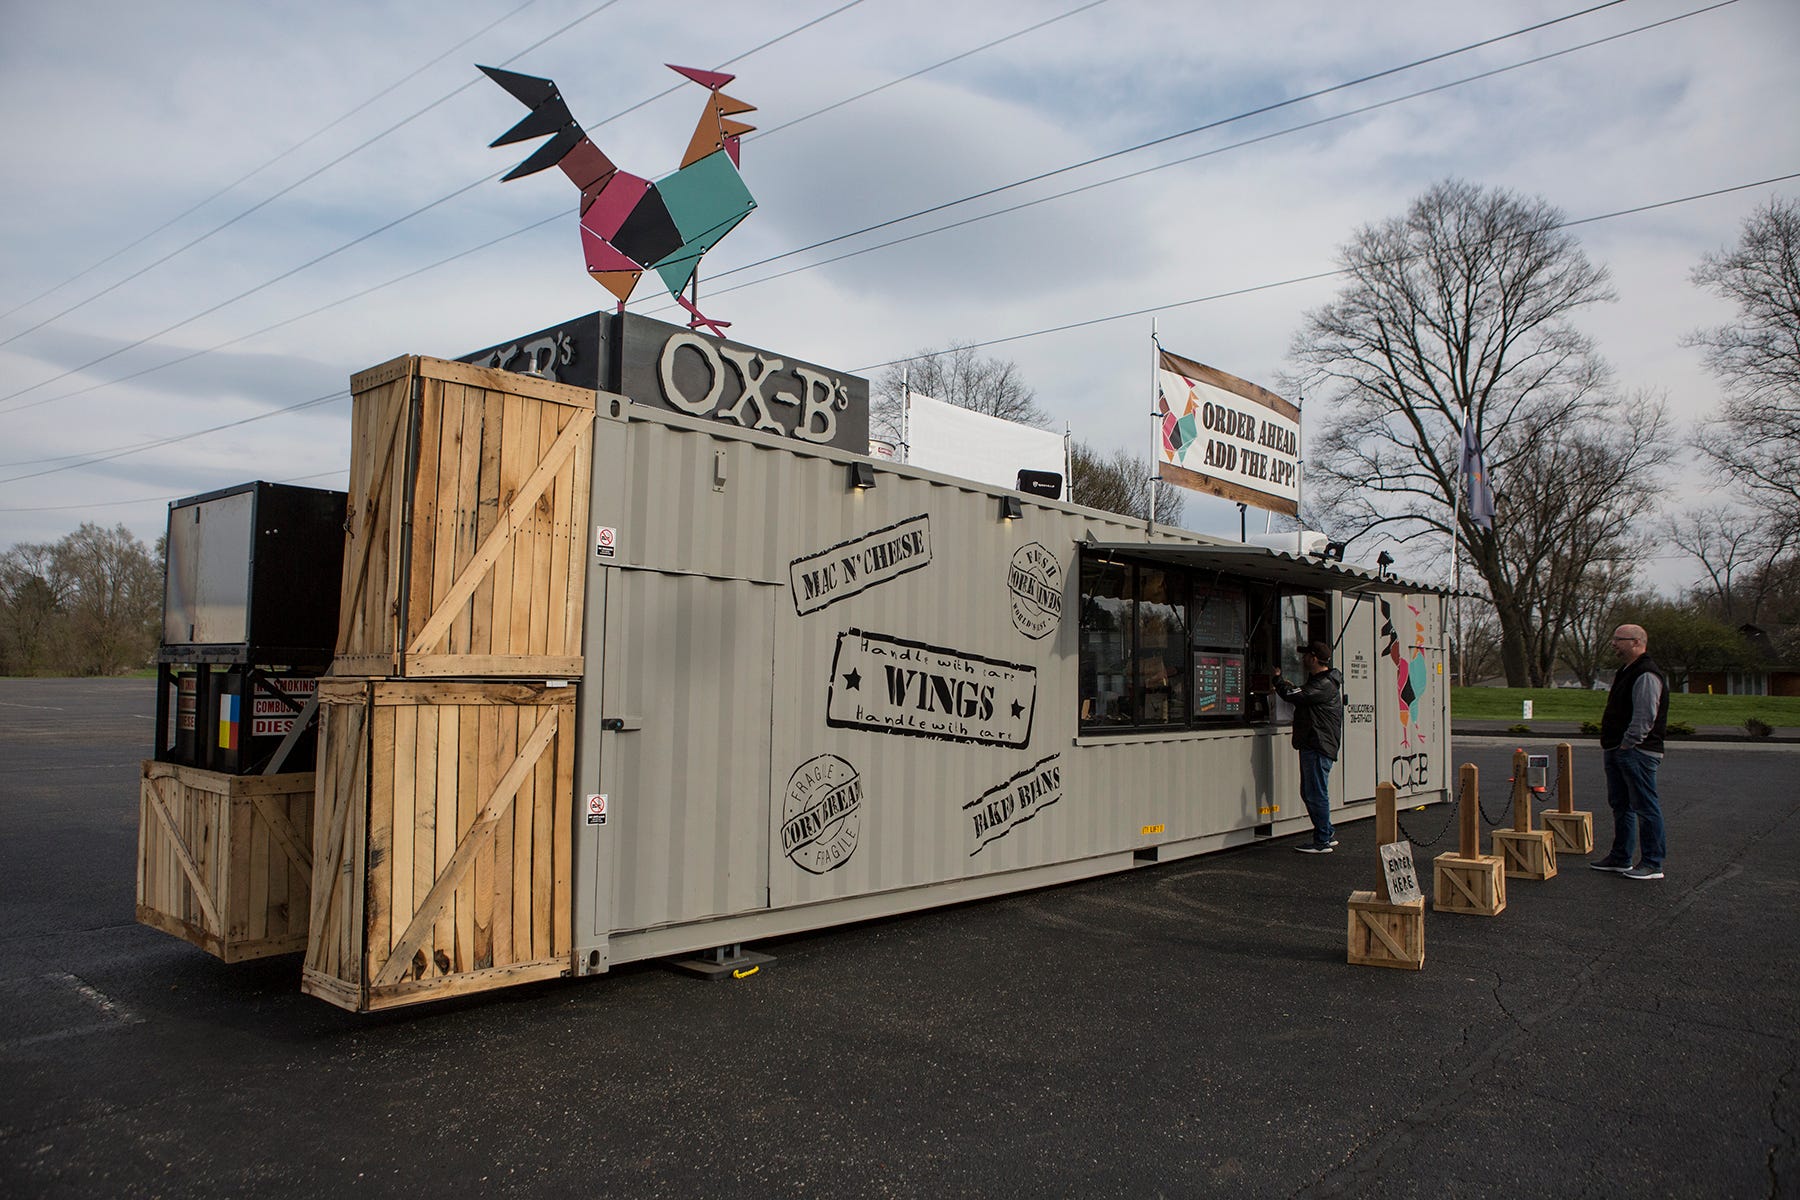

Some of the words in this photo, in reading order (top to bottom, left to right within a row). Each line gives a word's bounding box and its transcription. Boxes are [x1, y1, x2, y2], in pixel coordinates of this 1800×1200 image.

[657, 333, 847, 443] OX-B's
[1202, 402, 1256, 442] ORDER
[1204, 439, 1238, 471] ADD
[1240, 448, 1268, 480] THE
[1269, 458, 1296, 488] APP!
[801, 559, 838, 600] MAC
[274, 680, 315, 693] SMOKING
[884, 664, 995, 721] WINGS
[256, 721, 293, 733] DIES
[784, 808, 821, 850] CORN
